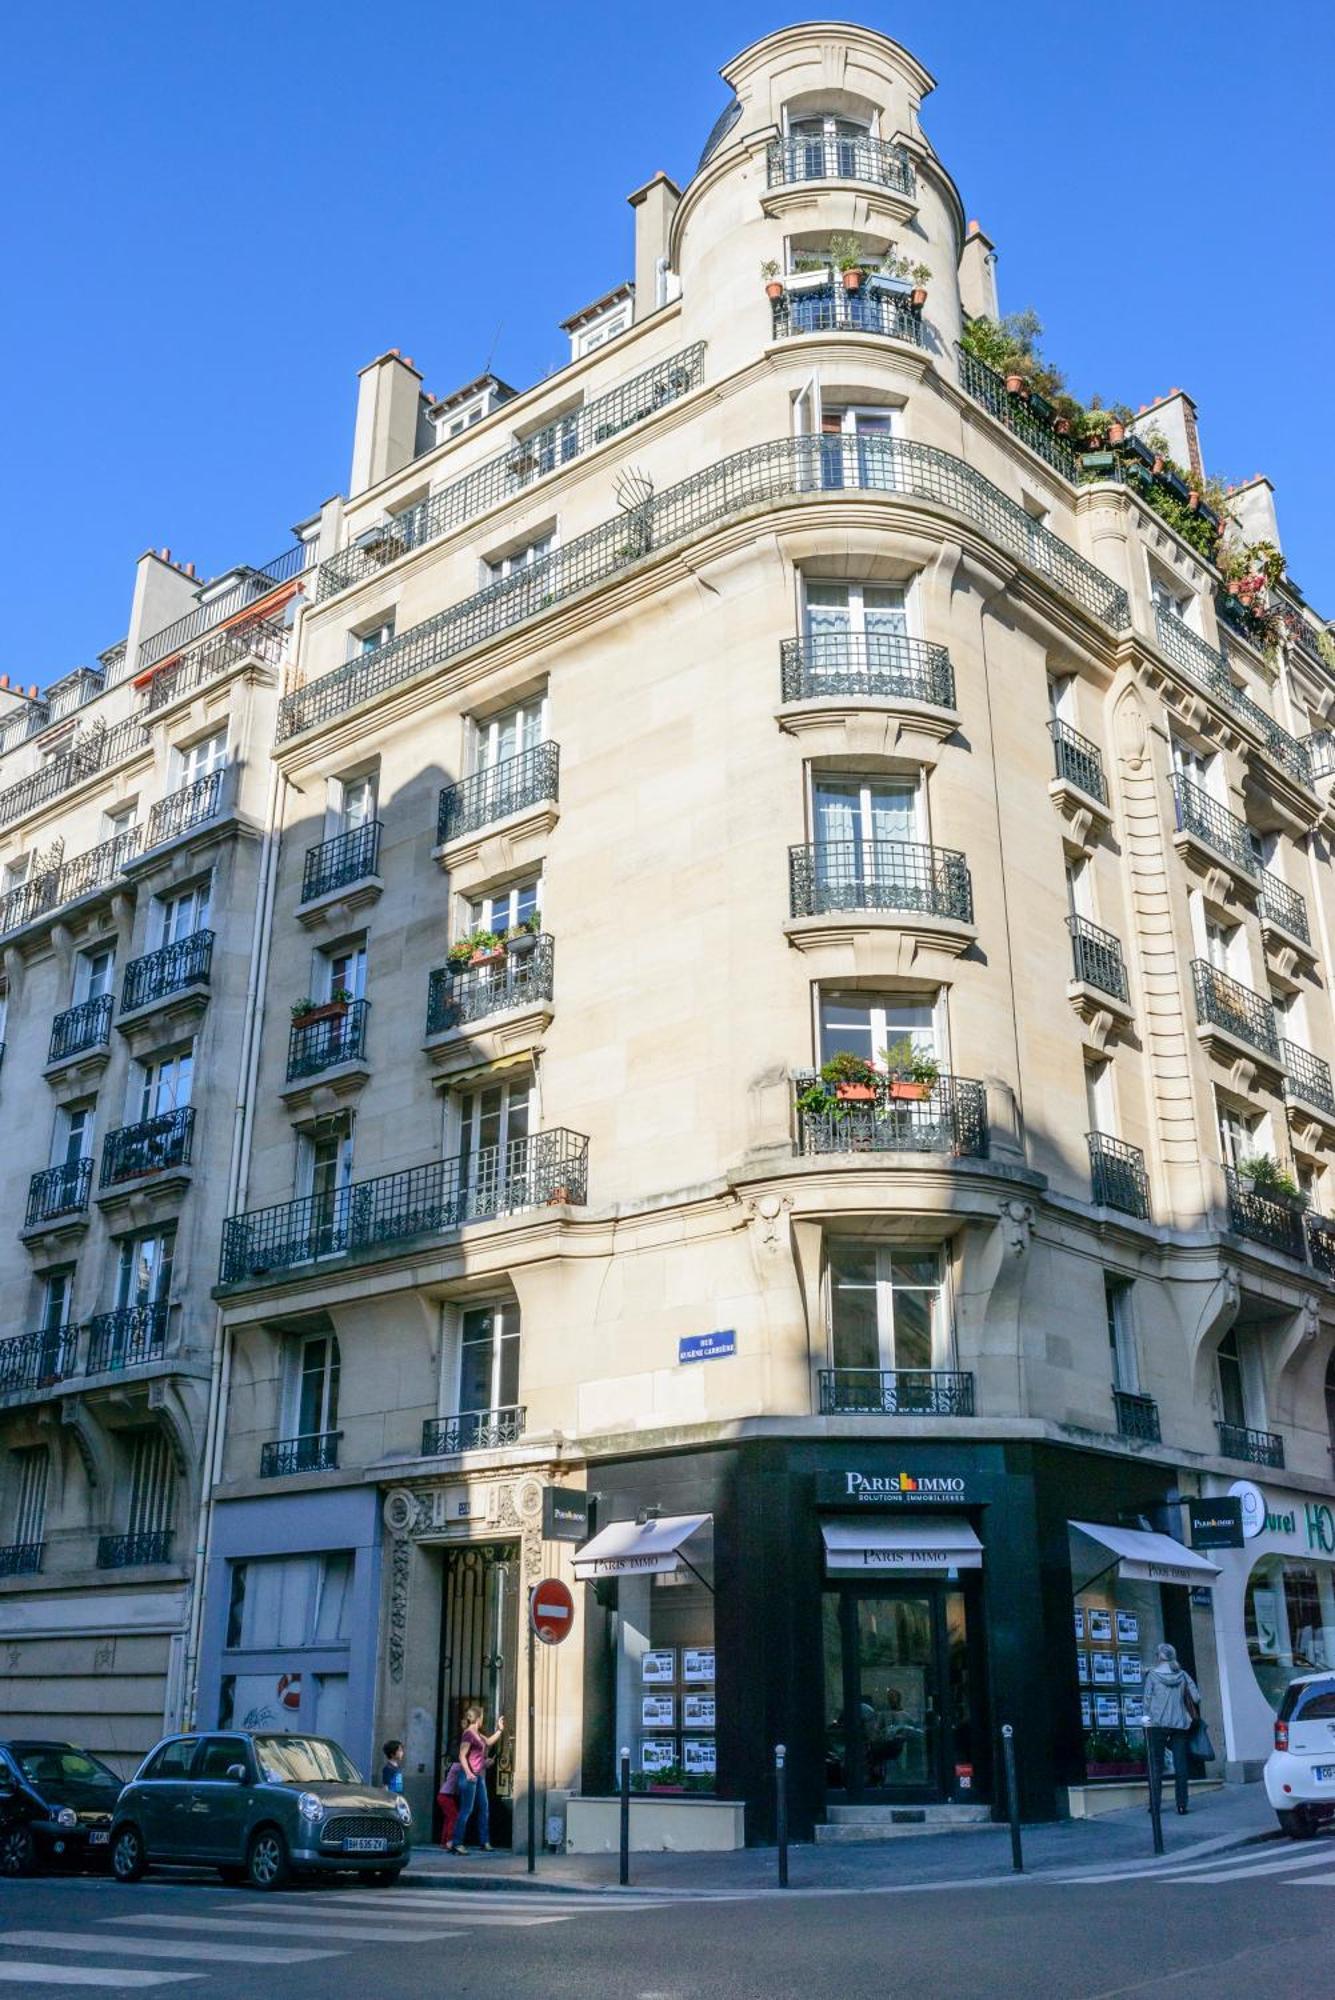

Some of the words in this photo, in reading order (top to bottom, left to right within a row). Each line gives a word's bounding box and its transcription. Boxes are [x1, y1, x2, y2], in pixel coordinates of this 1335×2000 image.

[845, 1471, 899, 1494] PARIS
[918, 1478, 965, 1491] IMMO
[863, 1549, 904, 1564] PARIS
[911, 1551, 948, 1562] IMMO
[594, 1559, 625, 1573] PARIS
[630, 1557, 658, 1569] IMMO
